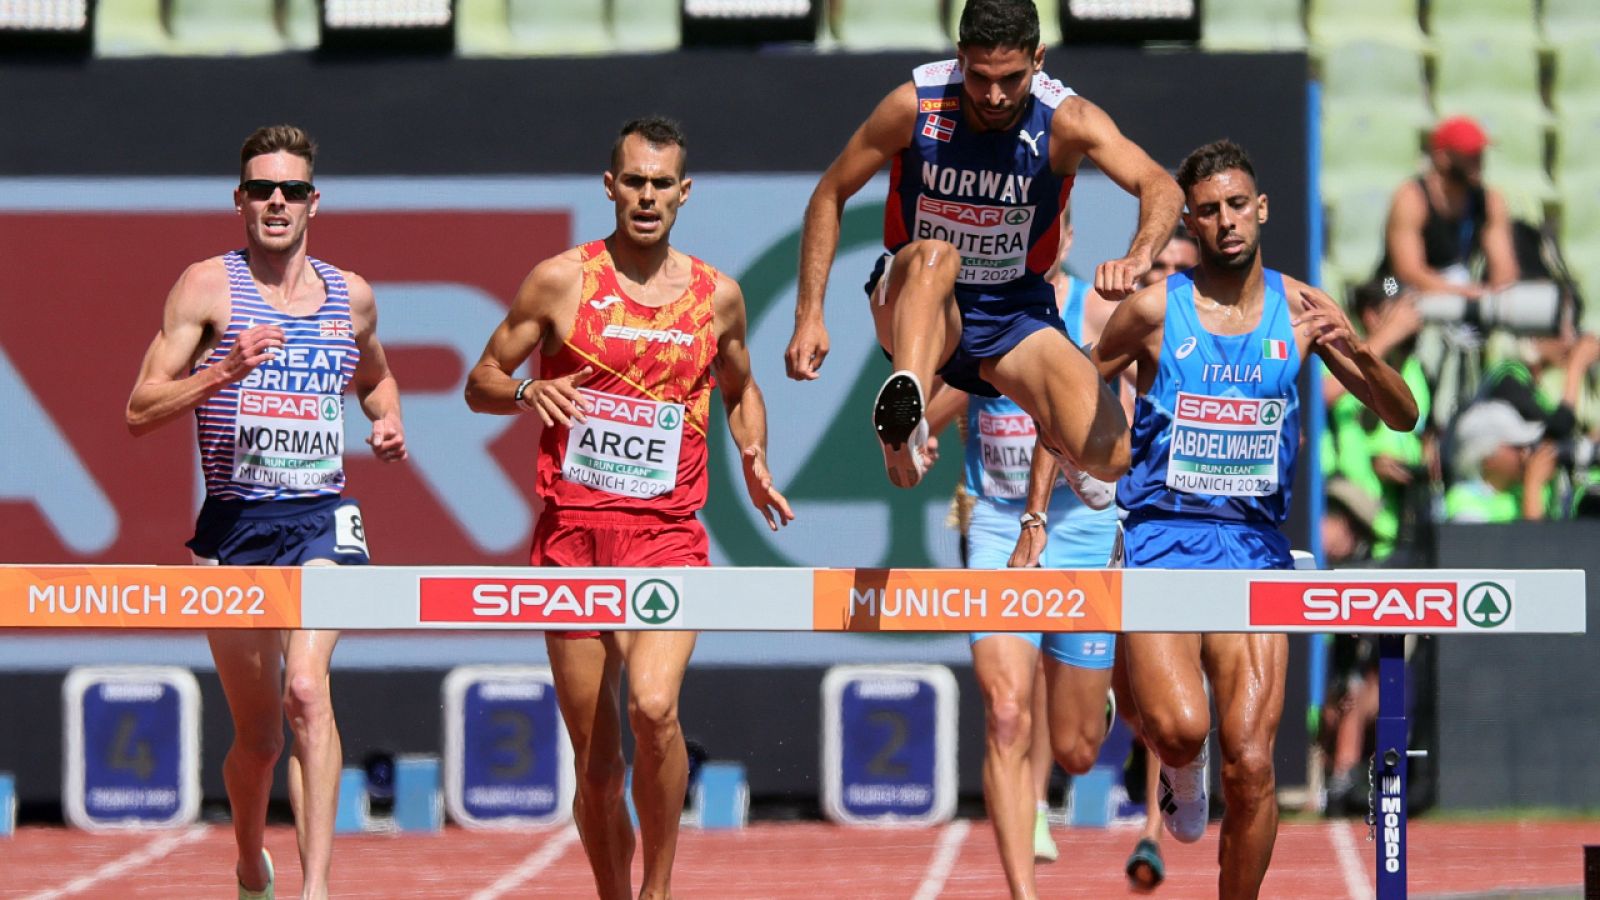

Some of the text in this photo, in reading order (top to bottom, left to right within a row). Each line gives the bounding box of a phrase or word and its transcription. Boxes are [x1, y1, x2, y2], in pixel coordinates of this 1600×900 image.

[922, 161, 1033, 204] NORWAY
[921, 202, 1000, 225] SPAR
[918, 221, 1024, 255] BOUTERA
[981, 268, 1018, 282] 2022
[602, 324, 695, 347] ESPAÑA
[263, 347, 347, 370] REAT
[1202, 364, 1262, 383] ITALIA
[240, 369, 344, 394] BRITAIN
[242, 394, 317, 417] SPAR
[576, 394, 656, 424] SPAR
[1180, 399, 1257, 422] SPAR
[239, 425, 339, 455] NORMAN
[578, 428, 666, 464] ARCE
[984, 443, 1034, 466] RAITA
[1173, 430, 1276, 460] ABDELWAHED
[239, 466, 337, 486] MUNICH 20
[568, 466, 667, 497] MUNICH 2022
[594, 460, 614, 473] RUN
[1201, 465, 1222, 474] RUN
[1174, 474, 1271, 492] MUNICH 2022
[350, 514, 364, 542] 8
[28, 584, 266, 615] MUNICH 2022
[472, 584, 622, 617] SPAR
[849, 588, 1086, 618] MUNICH 2022
[1303, 588, 1453, 621] SPAR
[107, 712, 155, 780] 4
[489, 709, 535, 779] 3
[865, 709, 910, 778] 2
[1381, 797, 1401, 873] MONDO
